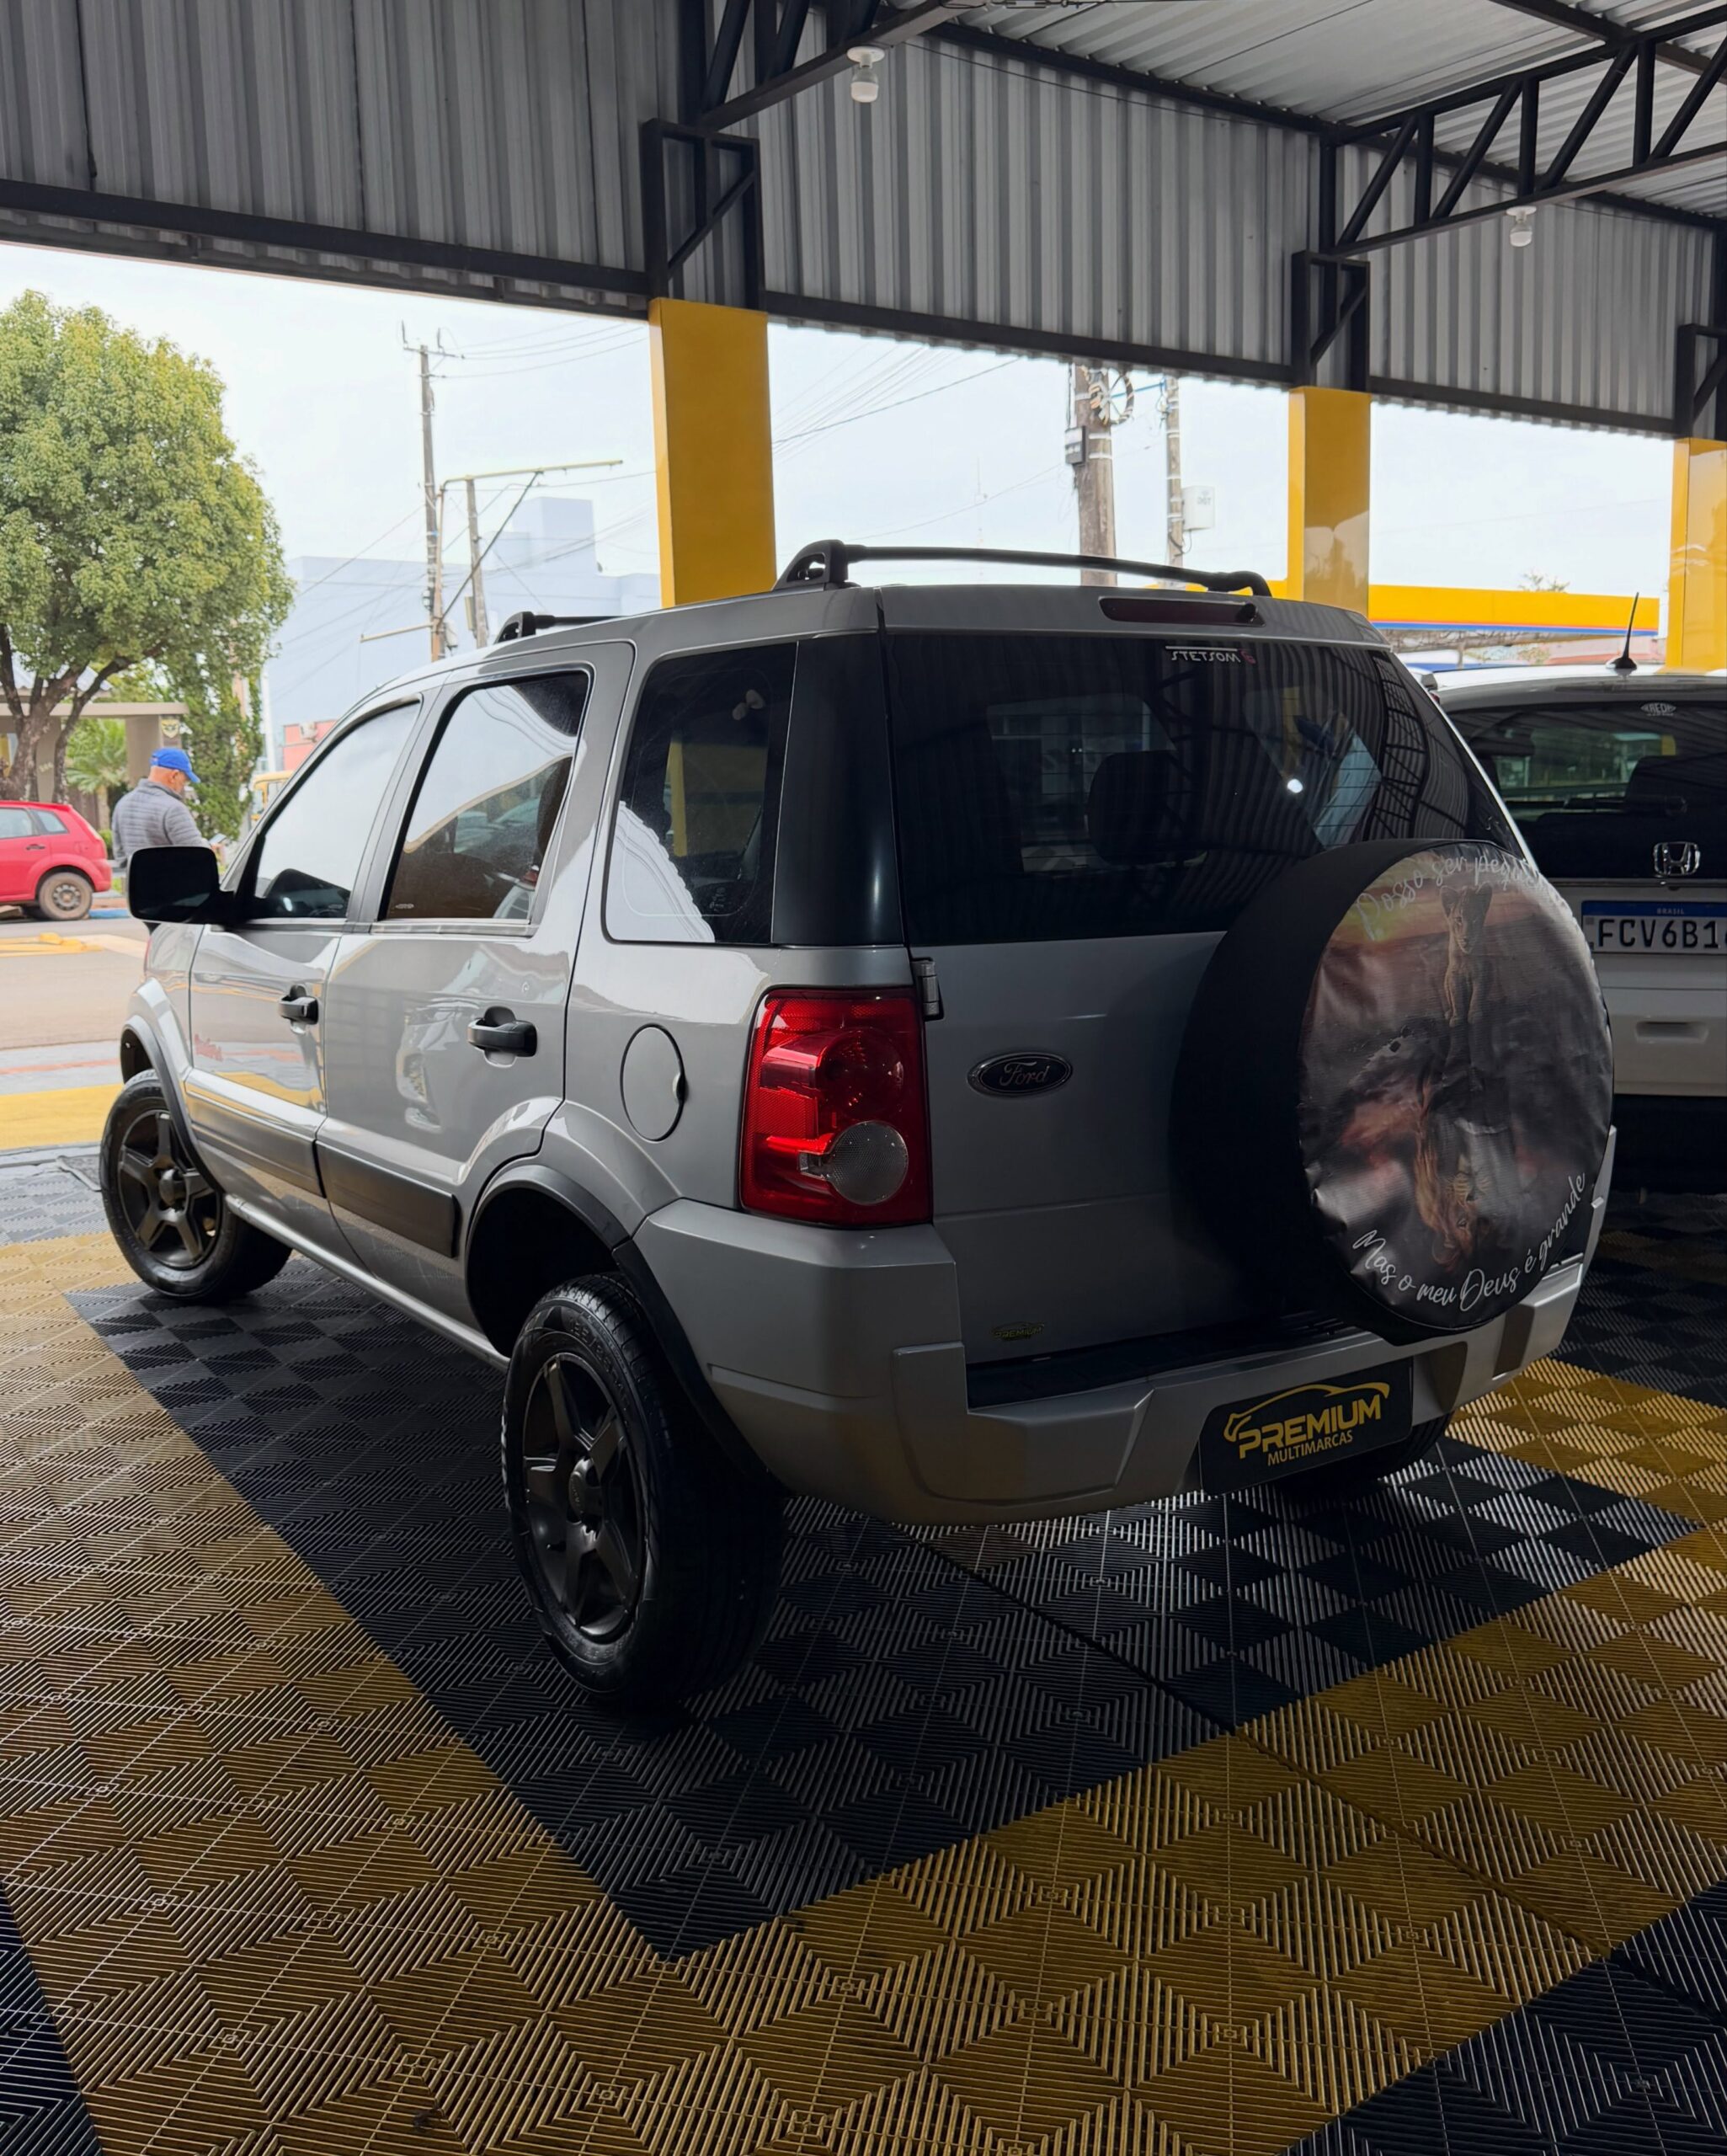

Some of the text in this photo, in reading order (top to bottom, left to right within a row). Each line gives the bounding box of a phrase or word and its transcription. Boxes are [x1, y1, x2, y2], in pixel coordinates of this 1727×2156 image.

[1170, 650, 1241, 663] STETSOM
[1656, 907, 1685, 915] BRASIL
[1597, 919, 1727, 949] FCV6B1
[999, 1060, 1050, 1086] Ford
[1351, 1172, 1586, 1311] Mas o meu Deus é grande
[1238, 1394, 1382, 1460] PREMIUM
[1267, 1429, 1353, 1466] MULTIMARCAS
